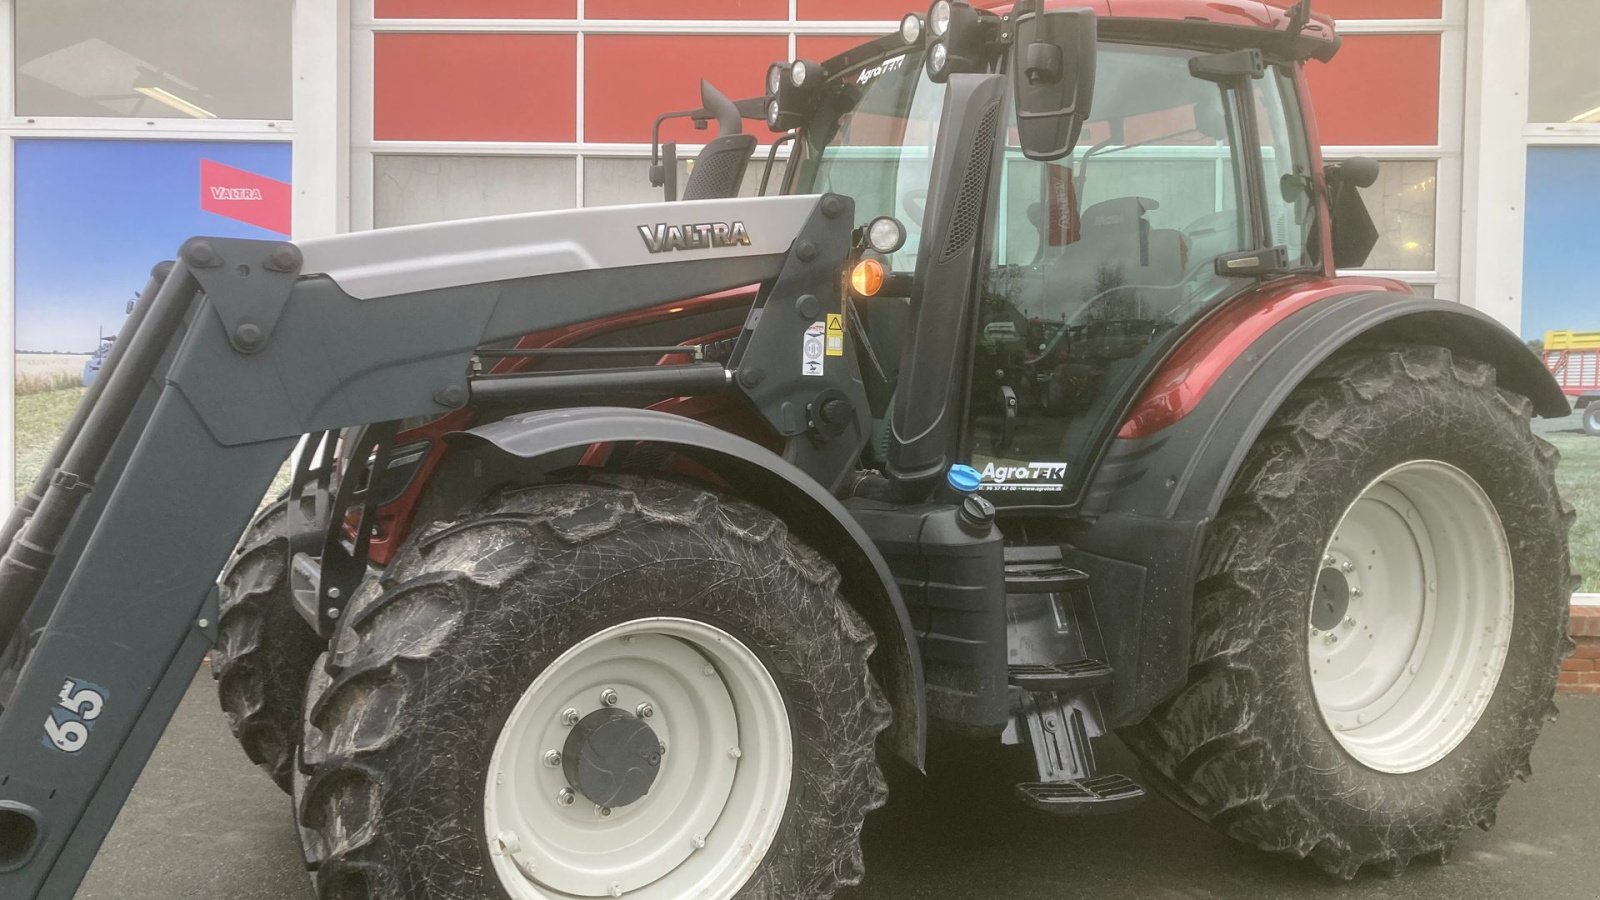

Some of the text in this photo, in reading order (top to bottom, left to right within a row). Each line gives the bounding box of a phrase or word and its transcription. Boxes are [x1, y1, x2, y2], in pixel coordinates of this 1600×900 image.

[210, 186, 262, 200] VALTRA
[637, 221, 751, 253] VALTRA
[981, 462, 1067, 483] AgroTEK
[43, 678, 104, 753] 65
